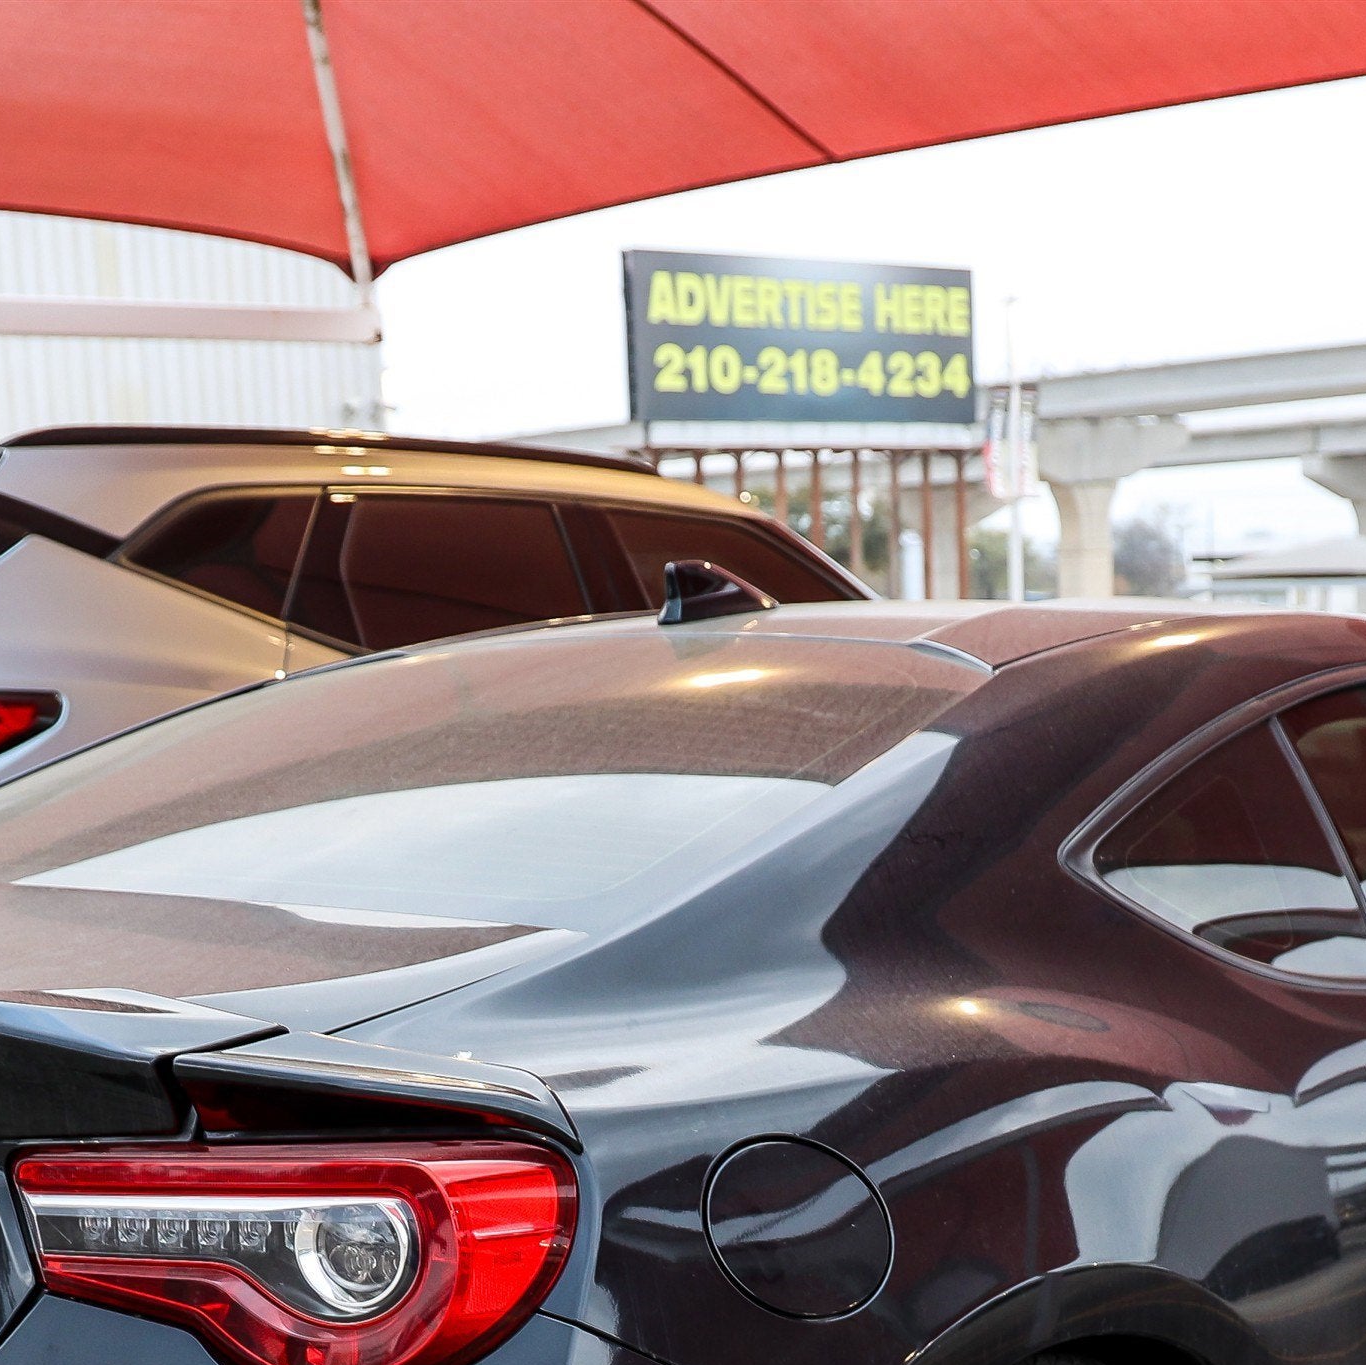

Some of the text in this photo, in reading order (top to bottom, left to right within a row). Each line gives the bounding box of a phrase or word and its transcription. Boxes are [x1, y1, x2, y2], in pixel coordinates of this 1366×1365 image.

[647, 269, 971, 338] ADVERTISE HERE
[652, 341, 972, 400] 210-218-4234
